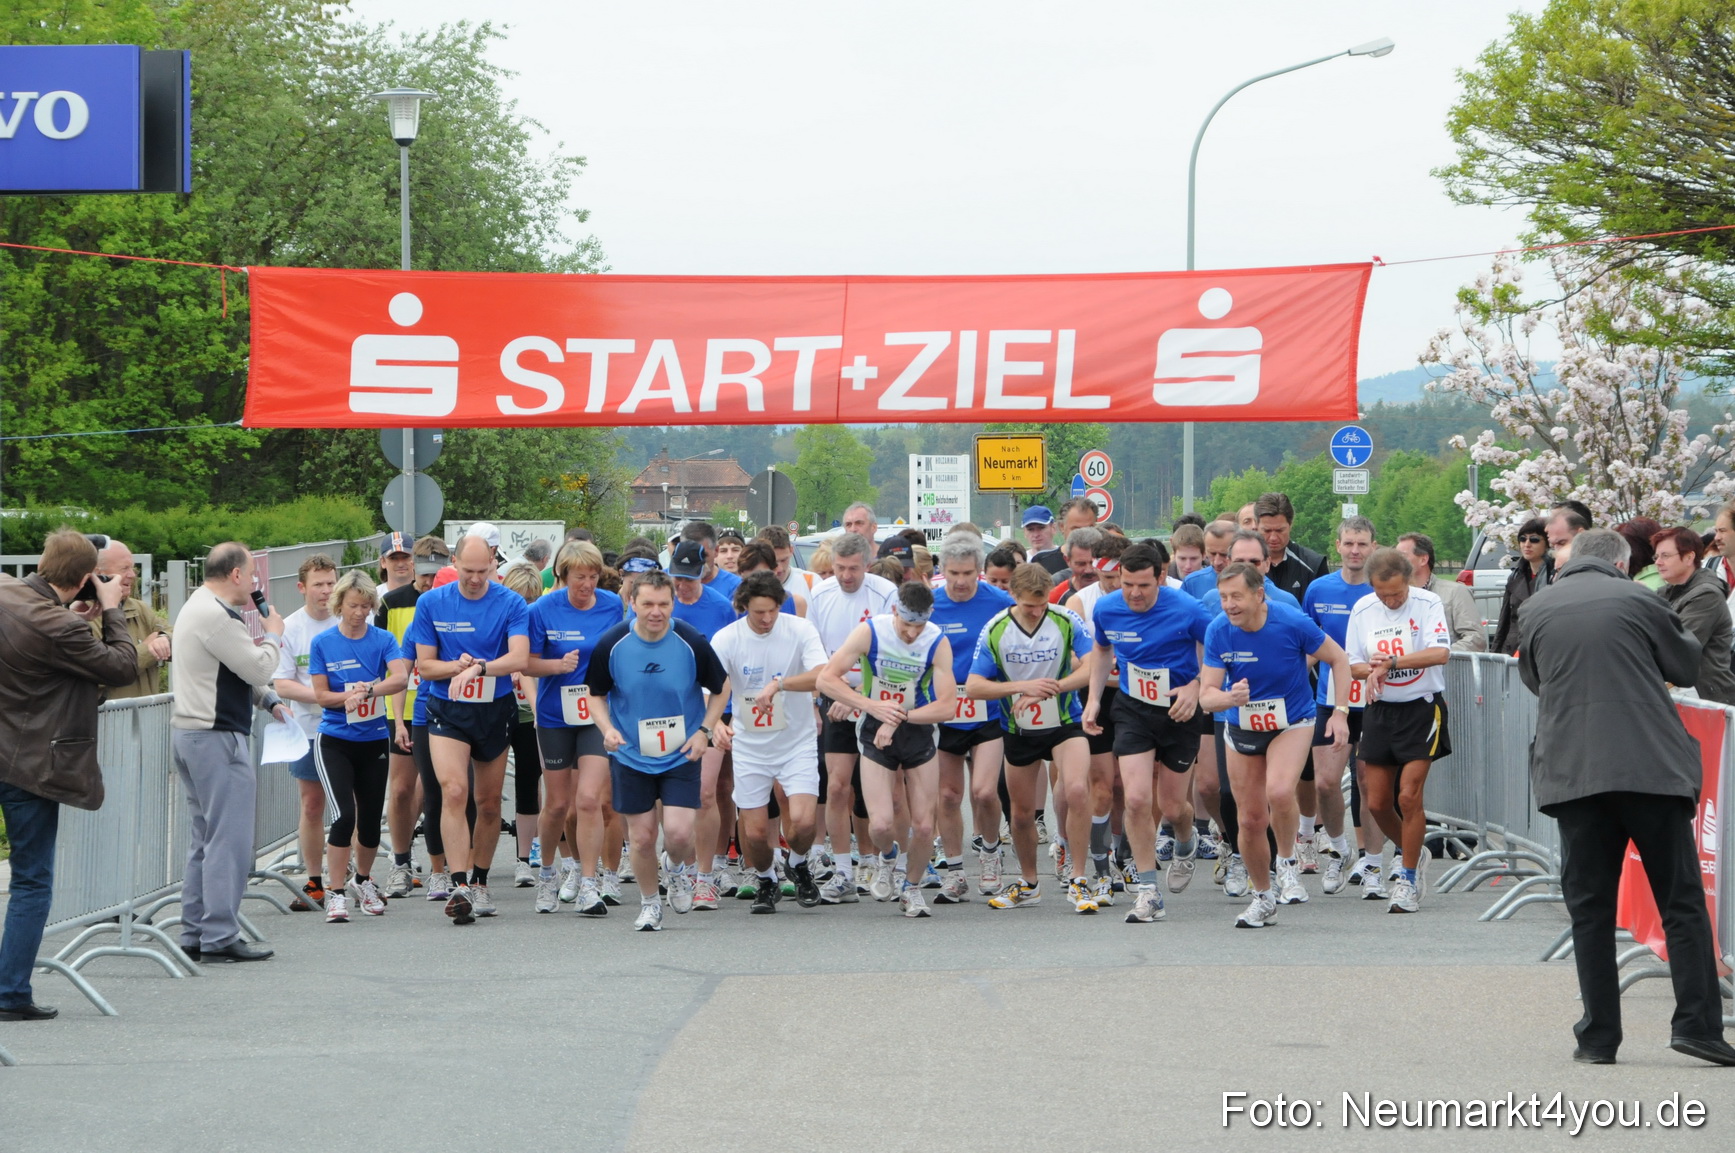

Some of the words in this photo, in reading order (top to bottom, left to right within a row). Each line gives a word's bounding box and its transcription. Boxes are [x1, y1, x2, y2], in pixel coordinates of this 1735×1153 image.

[1001, 445, 1020, 453] Nach
[983, 456, 1038, 469] Neumarkt
[1087, 460, 1106, 477] 60
[1002, 473, 1007, 481] 5
[923, 528, 942, 541] THULE
[1374, 627, 1394, 636] MEYER
[1005, 648, 1058, 664] BOCK
[881, 659, 923, 673] BOCK
[1133, 667, 1151, 676] MEYER
[463, 677, 484, 699] 61
[879, 680, 898, 688] MEYER
[1137, 678, 1158, 701] 16
[577, 696, 590, 720] 9
[955, 697, 976, 718] 73
[1030, 703, 1044, 726] 2
[1250, 713, 1278, 731] 66
[657, 730, 666, 752] 1
